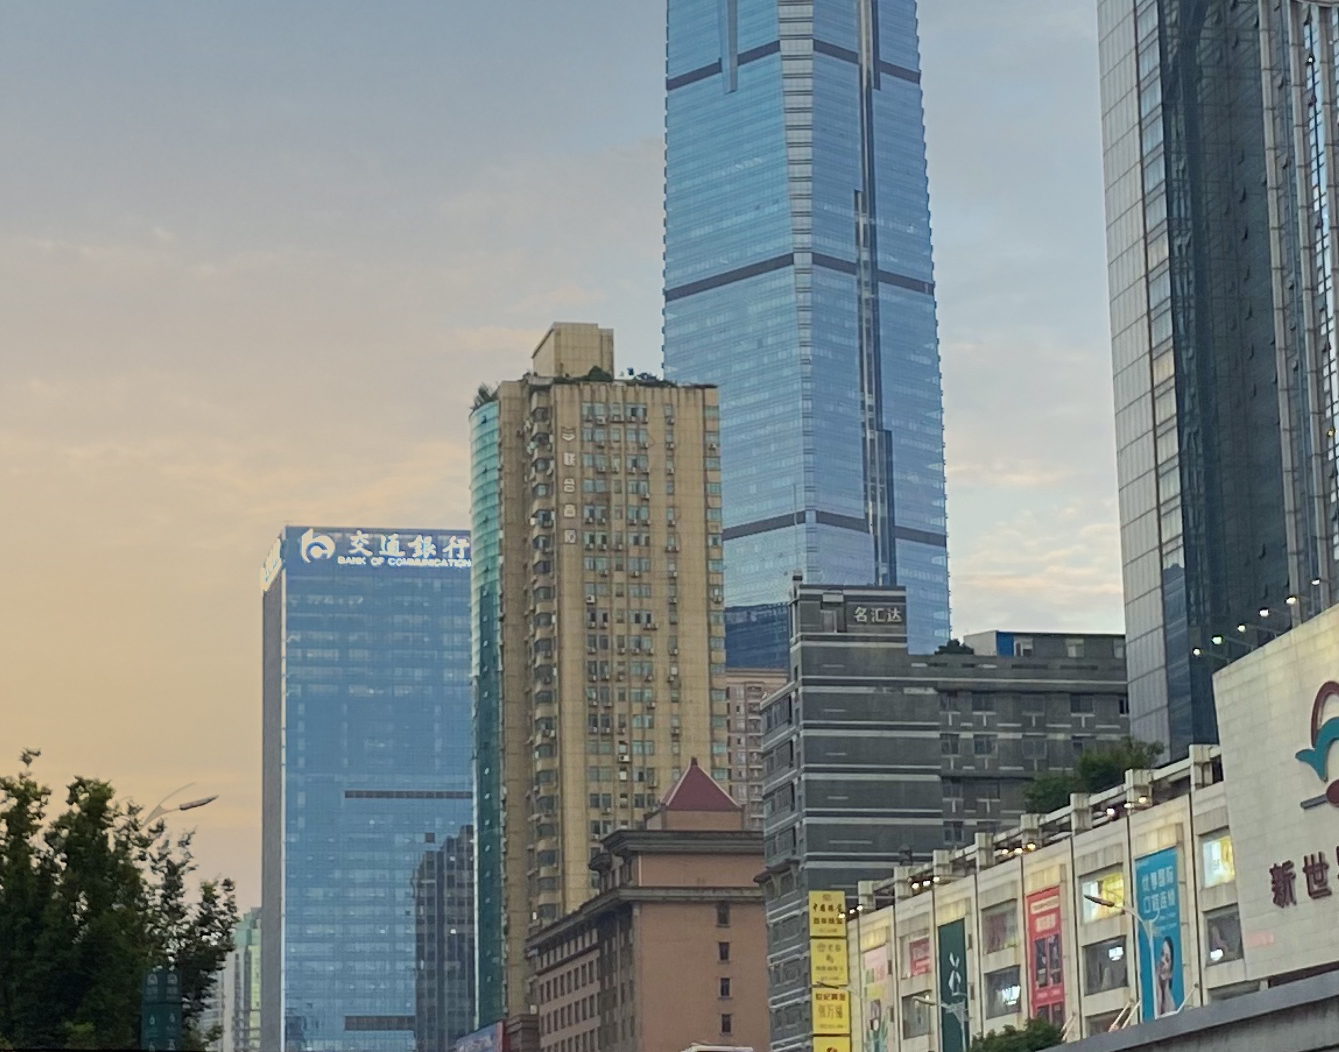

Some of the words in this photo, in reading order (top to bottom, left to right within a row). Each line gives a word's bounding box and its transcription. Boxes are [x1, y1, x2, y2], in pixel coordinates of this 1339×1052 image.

[337, 555, 367, 566] BANK
[370, 556, 387, 567] OF
[853, 606, 903, 623] 名汇达
